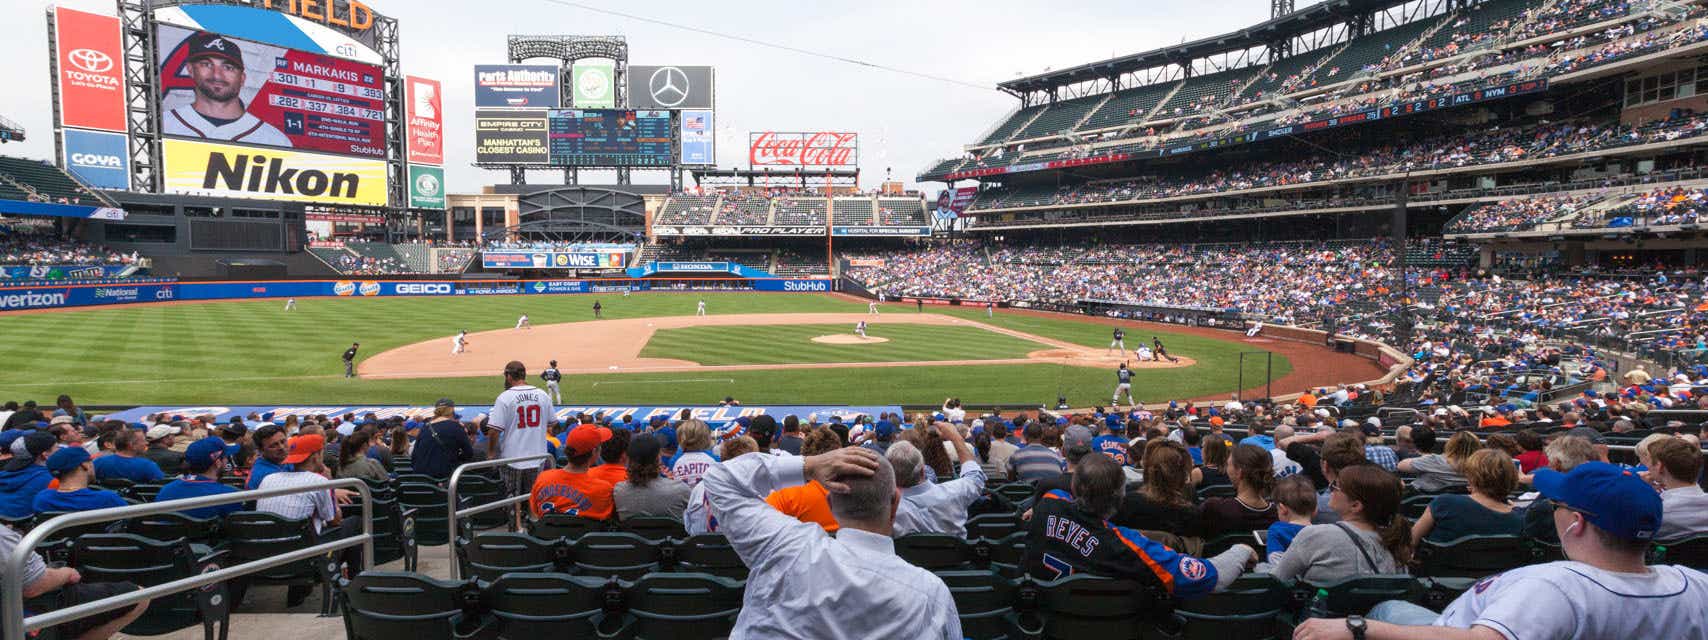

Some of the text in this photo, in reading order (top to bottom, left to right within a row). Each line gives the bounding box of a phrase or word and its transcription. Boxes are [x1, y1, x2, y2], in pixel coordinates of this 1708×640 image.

[264, 0, 373, 30] IELD
[65, 70, 120, 86] TOYOTA
[293, 62, 359, 81] MARKAKIS
[479, 69, 555, 82] Parts Authority
[276, 73, 298, 85] .301
[337, 83, 345, 93] 9
[1456, 94, 1471, 103] ATL
[1485, 88, 1505, 98] NYM
[277, 97, 383, 120] .282 .337 .384 .721
[1392, 106, 1399, 115] 2
[1415, 102, 1422, 111] 2
[1438, 98, 1445, 107] 2
[286, 118, 302, 129] 1-1
[411, 118, 440, 131] Affinity
[413, 128, 439, 140] Health
[418, 138, 434, 147] Plan
[350, 144, 384, 156] StubHub
[72, 153, 121, 166] GOYA
[203, 152, 359, 198] Nikon
[569, 254, 596, 266] WISE
[105, 288, 138, 297] National
[395, 283, 450, 294] GEICO
[784, 281, 826, 292] StubHub
[0, 290, 64, 308] verizon
[156, 288, 173, 299] citi
[516, 393, 539, 403] JONES
[517, 404, 541, 429] 10
[556, 407, 639, 421] CITI
[1046, 514, 1100, 558] REYES
